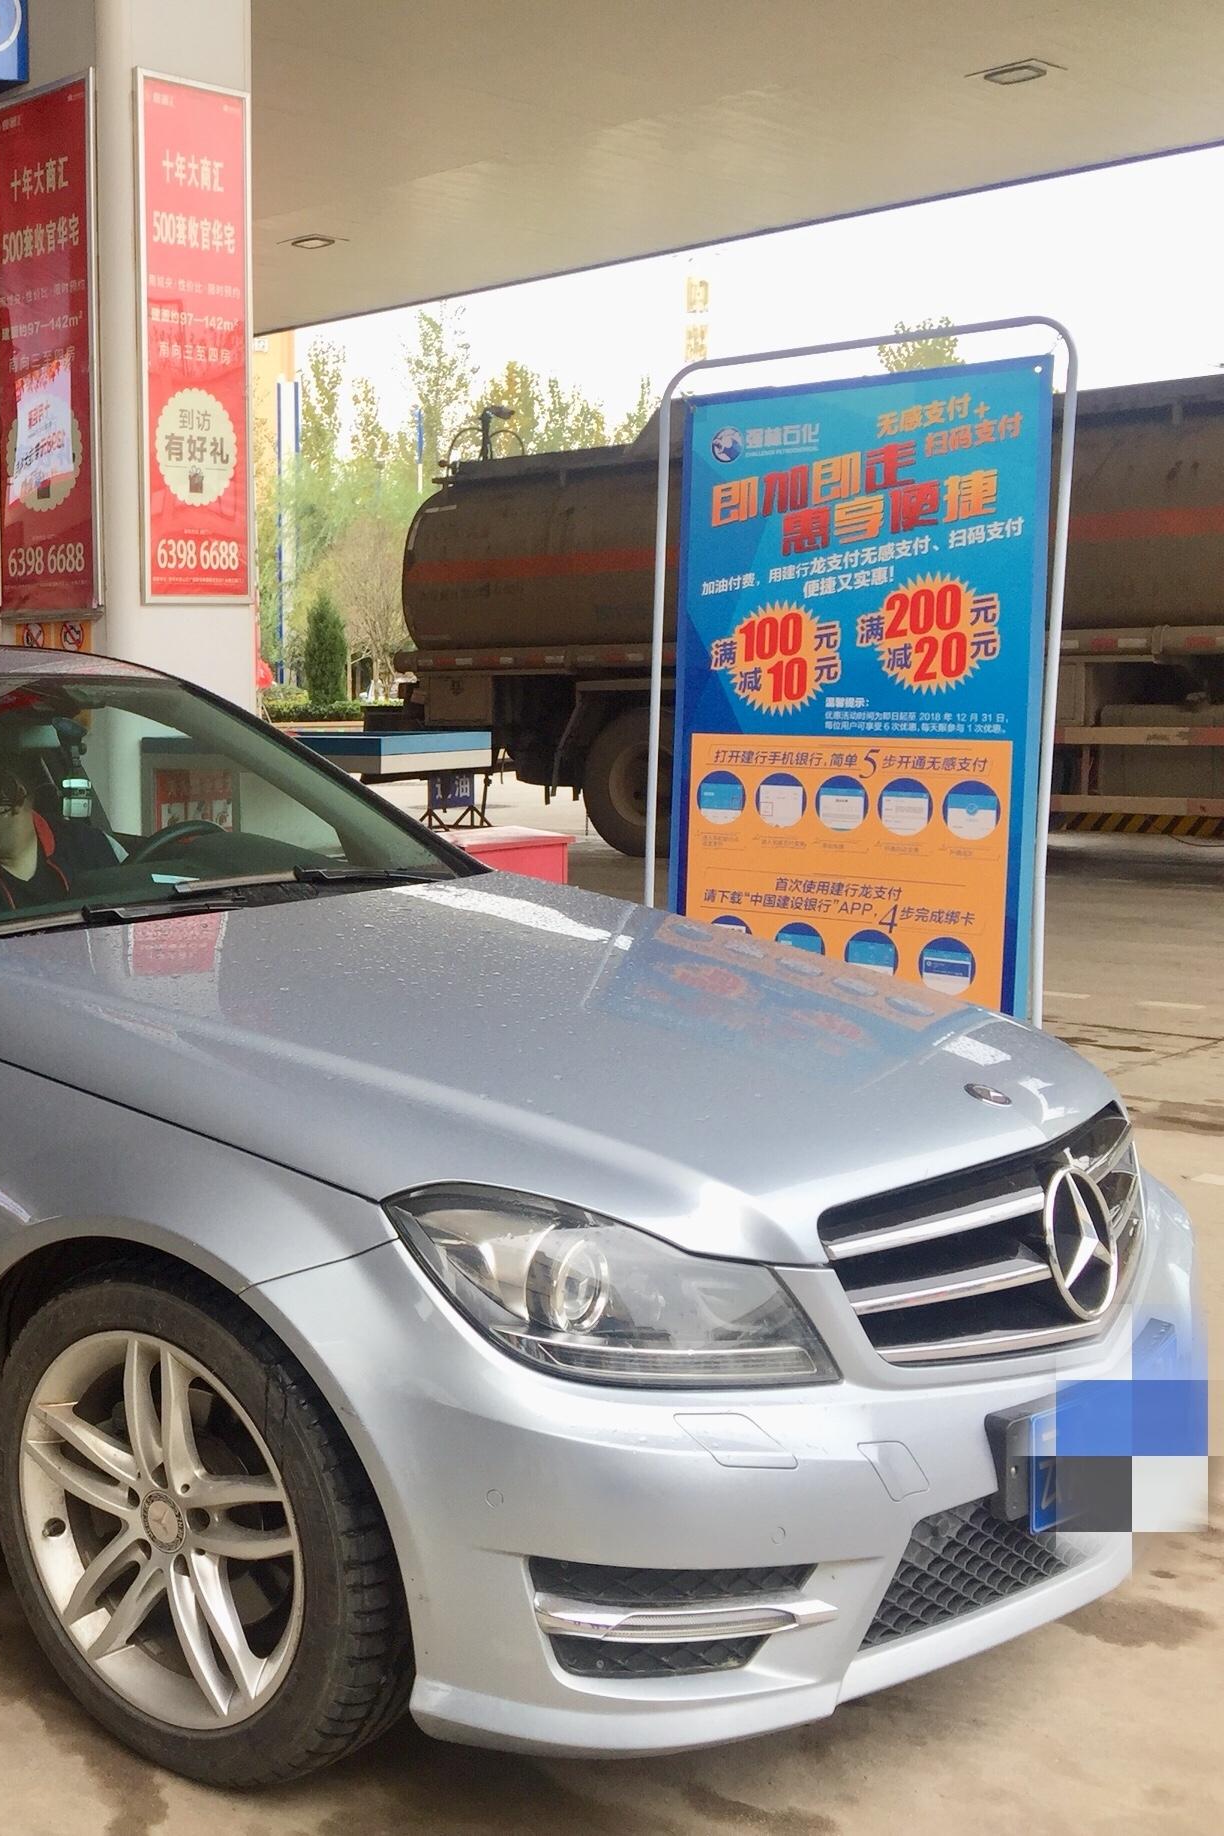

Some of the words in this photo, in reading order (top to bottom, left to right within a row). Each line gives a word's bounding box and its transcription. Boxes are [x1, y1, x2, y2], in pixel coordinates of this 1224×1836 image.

[10, 155, 69, 201] 十年大商汇
[162, 149, 224, 192] 十年大商汇
[2, 213, 79, 265] 500套收官华宅
[152, 211, 236, 255] 500套收官华宅
[179, 408, 211, 432] 到访
[925, 411, 1022, 456] 扫码支付
[165, 433, 229, 464] 有好礼
[711, 440, 916, 527] 即加即走
[781, 469, 998, 556] 惠享便捷
[8, 547, 43, 577] 6398
[47, 542, 85, 574] 6688
[157, 539, 197, 569] 6398
[200, 540, 239, 570] 6688
[919, 712, 941, 721] 2018
[943, 713, 952, 721] 年
[956, 713, 966, 721] 12
[969, 713, 978, 722] 月
[981, 713, 992, 722] 31
[775, 877, 902, 901] 首次使用建行龙支付
